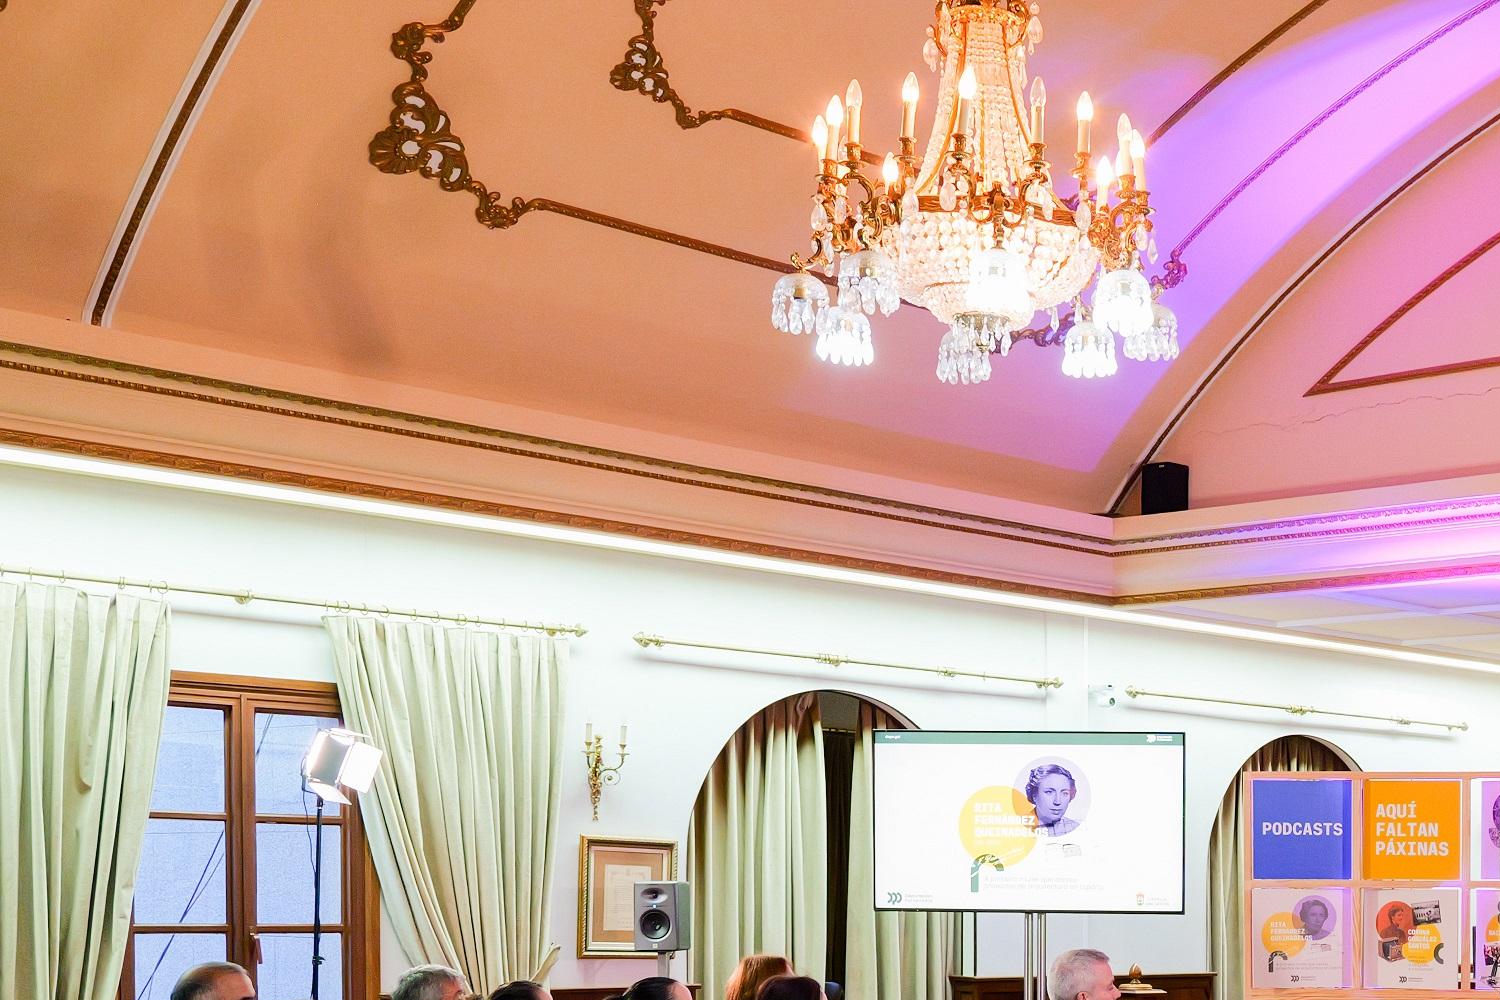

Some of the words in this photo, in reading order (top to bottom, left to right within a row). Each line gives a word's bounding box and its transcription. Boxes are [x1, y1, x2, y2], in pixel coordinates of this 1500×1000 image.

[1375, 800, 1417, 819] AQUÍ
[1262, 822, 1344, 836] PODCASTS
[1376, 822, 1439, 837] FALTAN
[1375, 838, 1449, 856] PÁXINAS
